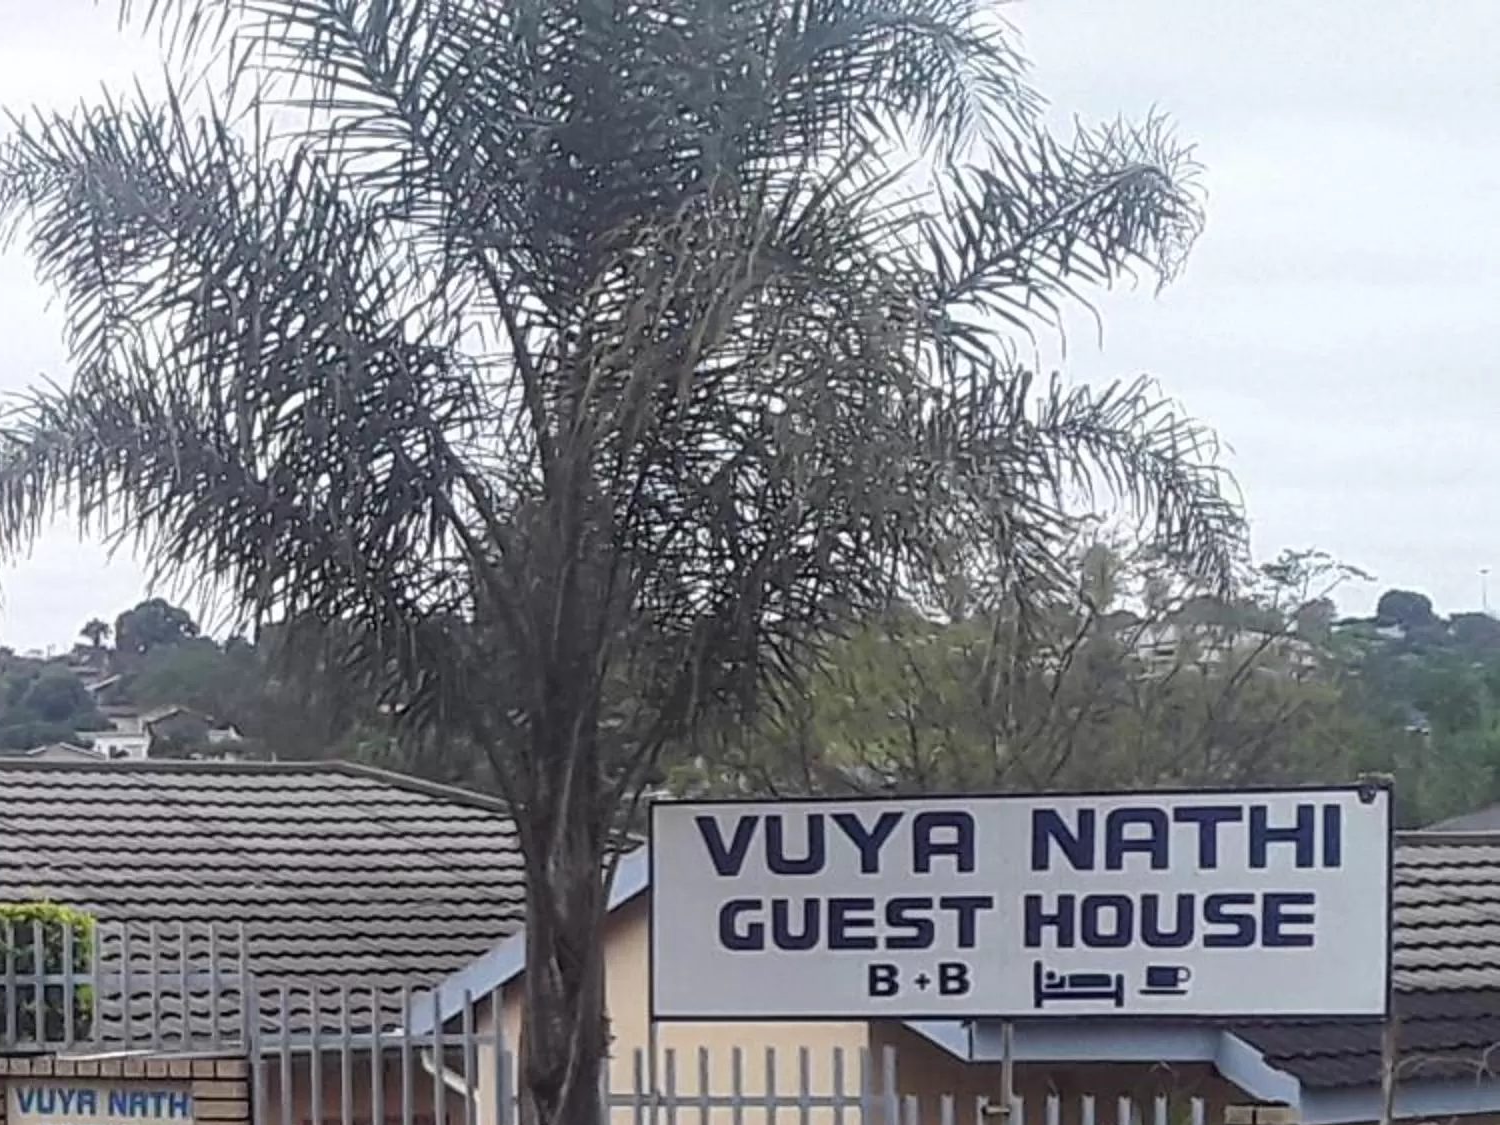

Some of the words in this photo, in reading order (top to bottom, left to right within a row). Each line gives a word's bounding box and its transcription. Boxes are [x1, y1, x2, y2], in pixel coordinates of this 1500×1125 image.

[694, 811, 976, 877] VUYA
[1030, 803, 1342, 872] NATHI
[718, 896, 994, 952] GUEST
[1023, 893, 1316, 949] HOUSE
[16, 1087, 98, 1115] VUYA
